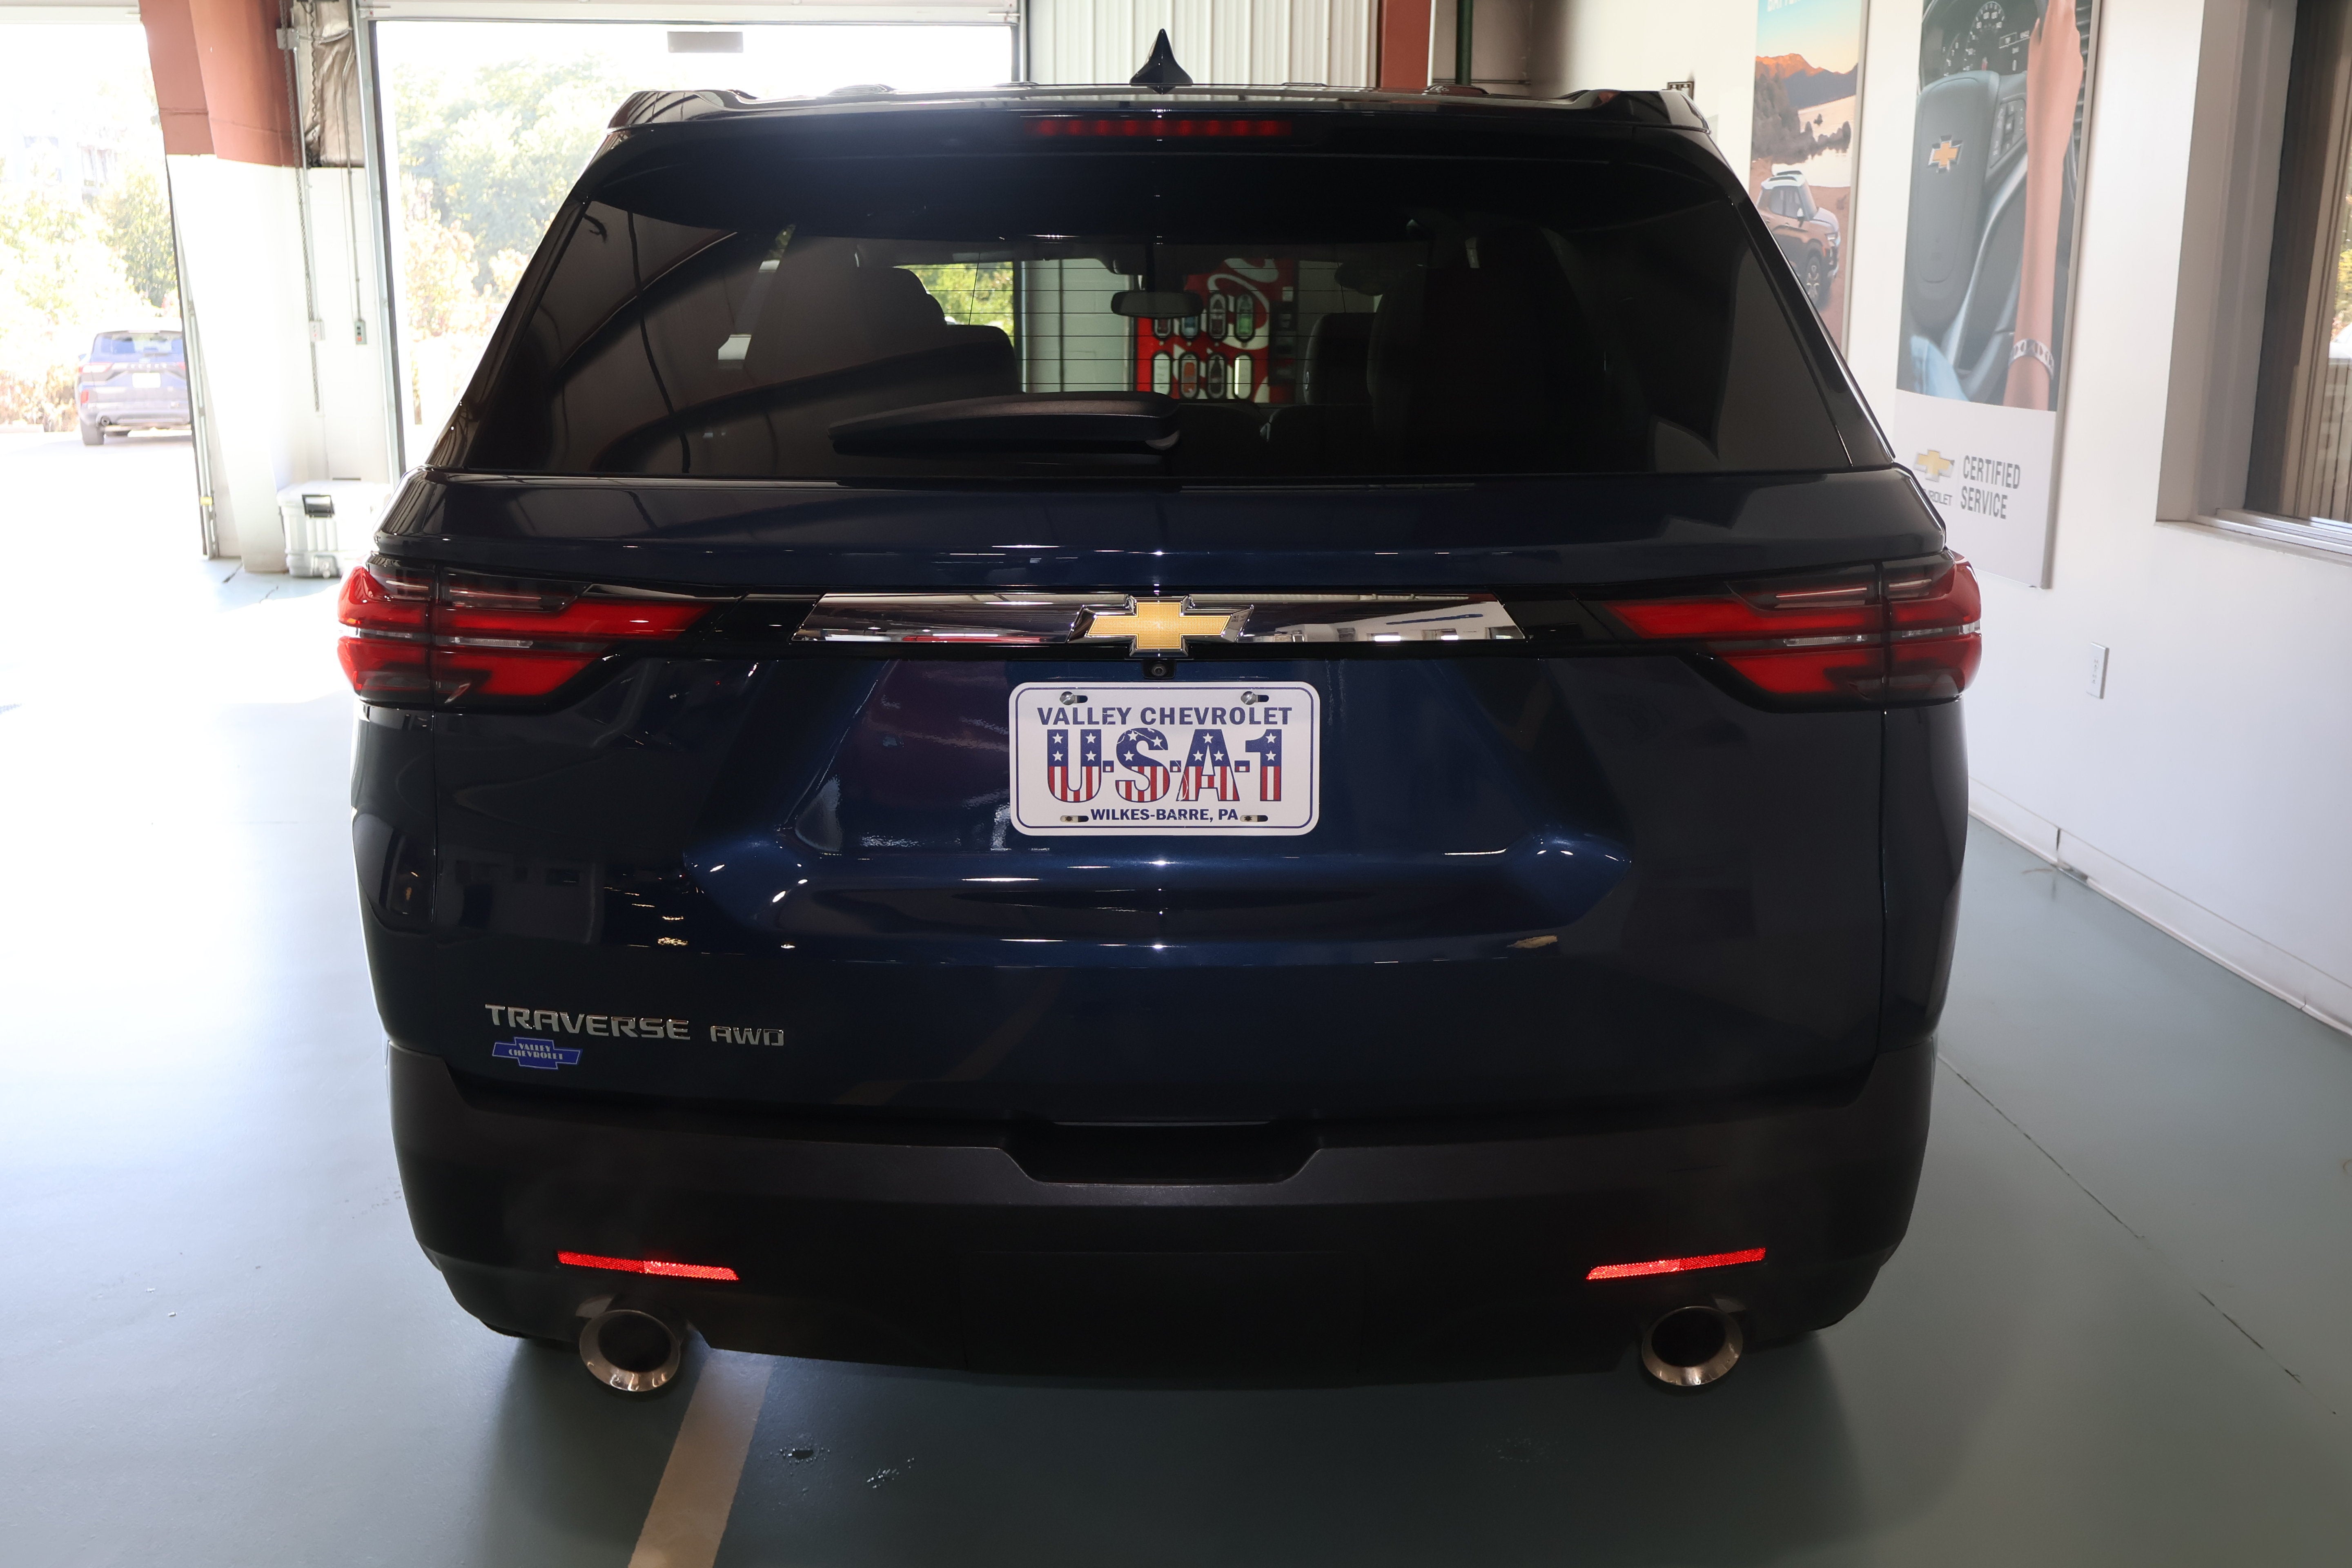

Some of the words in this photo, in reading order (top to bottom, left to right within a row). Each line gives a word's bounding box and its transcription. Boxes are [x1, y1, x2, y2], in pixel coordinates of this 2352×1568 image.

[1963, 454, 2021, 489] CERTIFIED
[1922, 488, 1953, 506] ROLET
[1960, 486, 2008, 519] SERVICE
[1037, 706, 1131, 725] VALLEY
[1140, 706, 1292, 725] CHEVROLET
[1090, 808, 1213, 822] WILKES-BARRE,
[1218, 808, 1238, 821] PA
[485, 1004, 690, 1040] TRAVERSE
[710, 1025, 784, 1046] AWD
[508, 1049, 563, 1060] CHEVROLET
[518, 1043, 551, 1052] VALLEY
